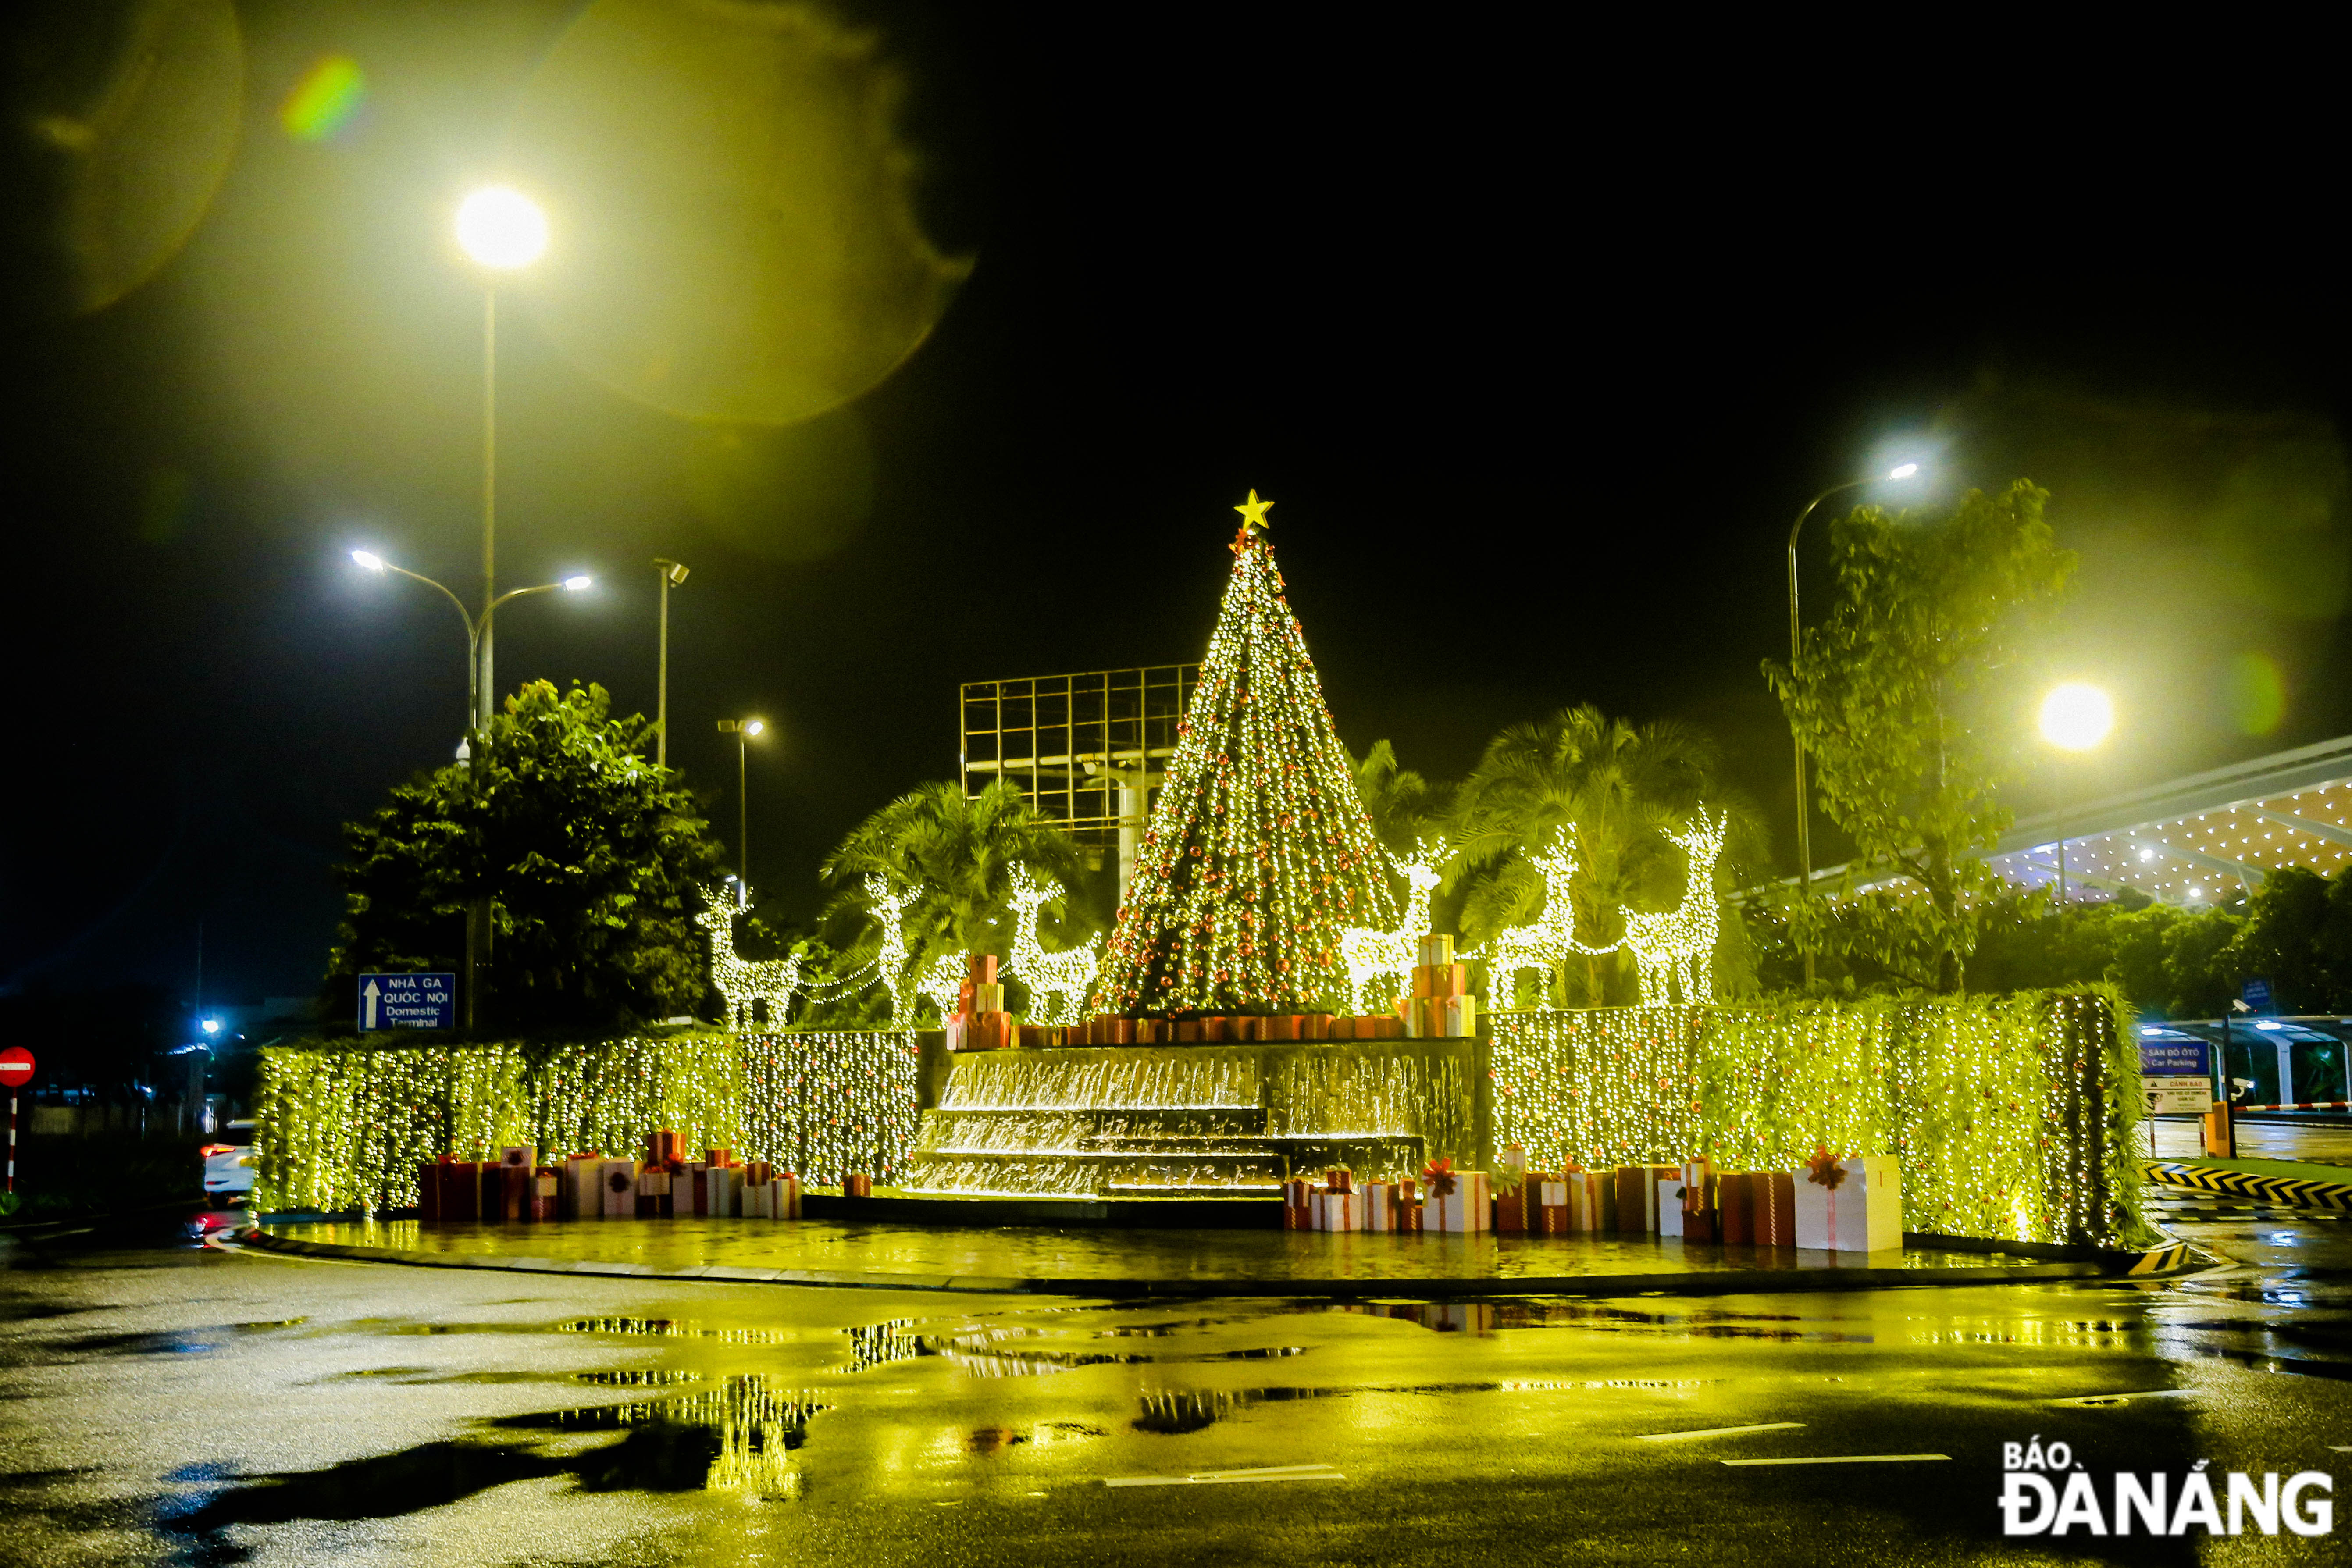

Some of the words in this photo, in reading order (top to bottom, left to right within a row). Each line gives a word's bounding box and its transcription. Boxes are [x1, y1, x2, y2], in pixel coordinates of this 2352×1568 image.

[423, 978, 442, 988] GA
[386, 1006, 440, 1016] Domestic
[390, 1018, 438, 1027] Terminal
[2167, 1059, 2197, 1068] Parking
